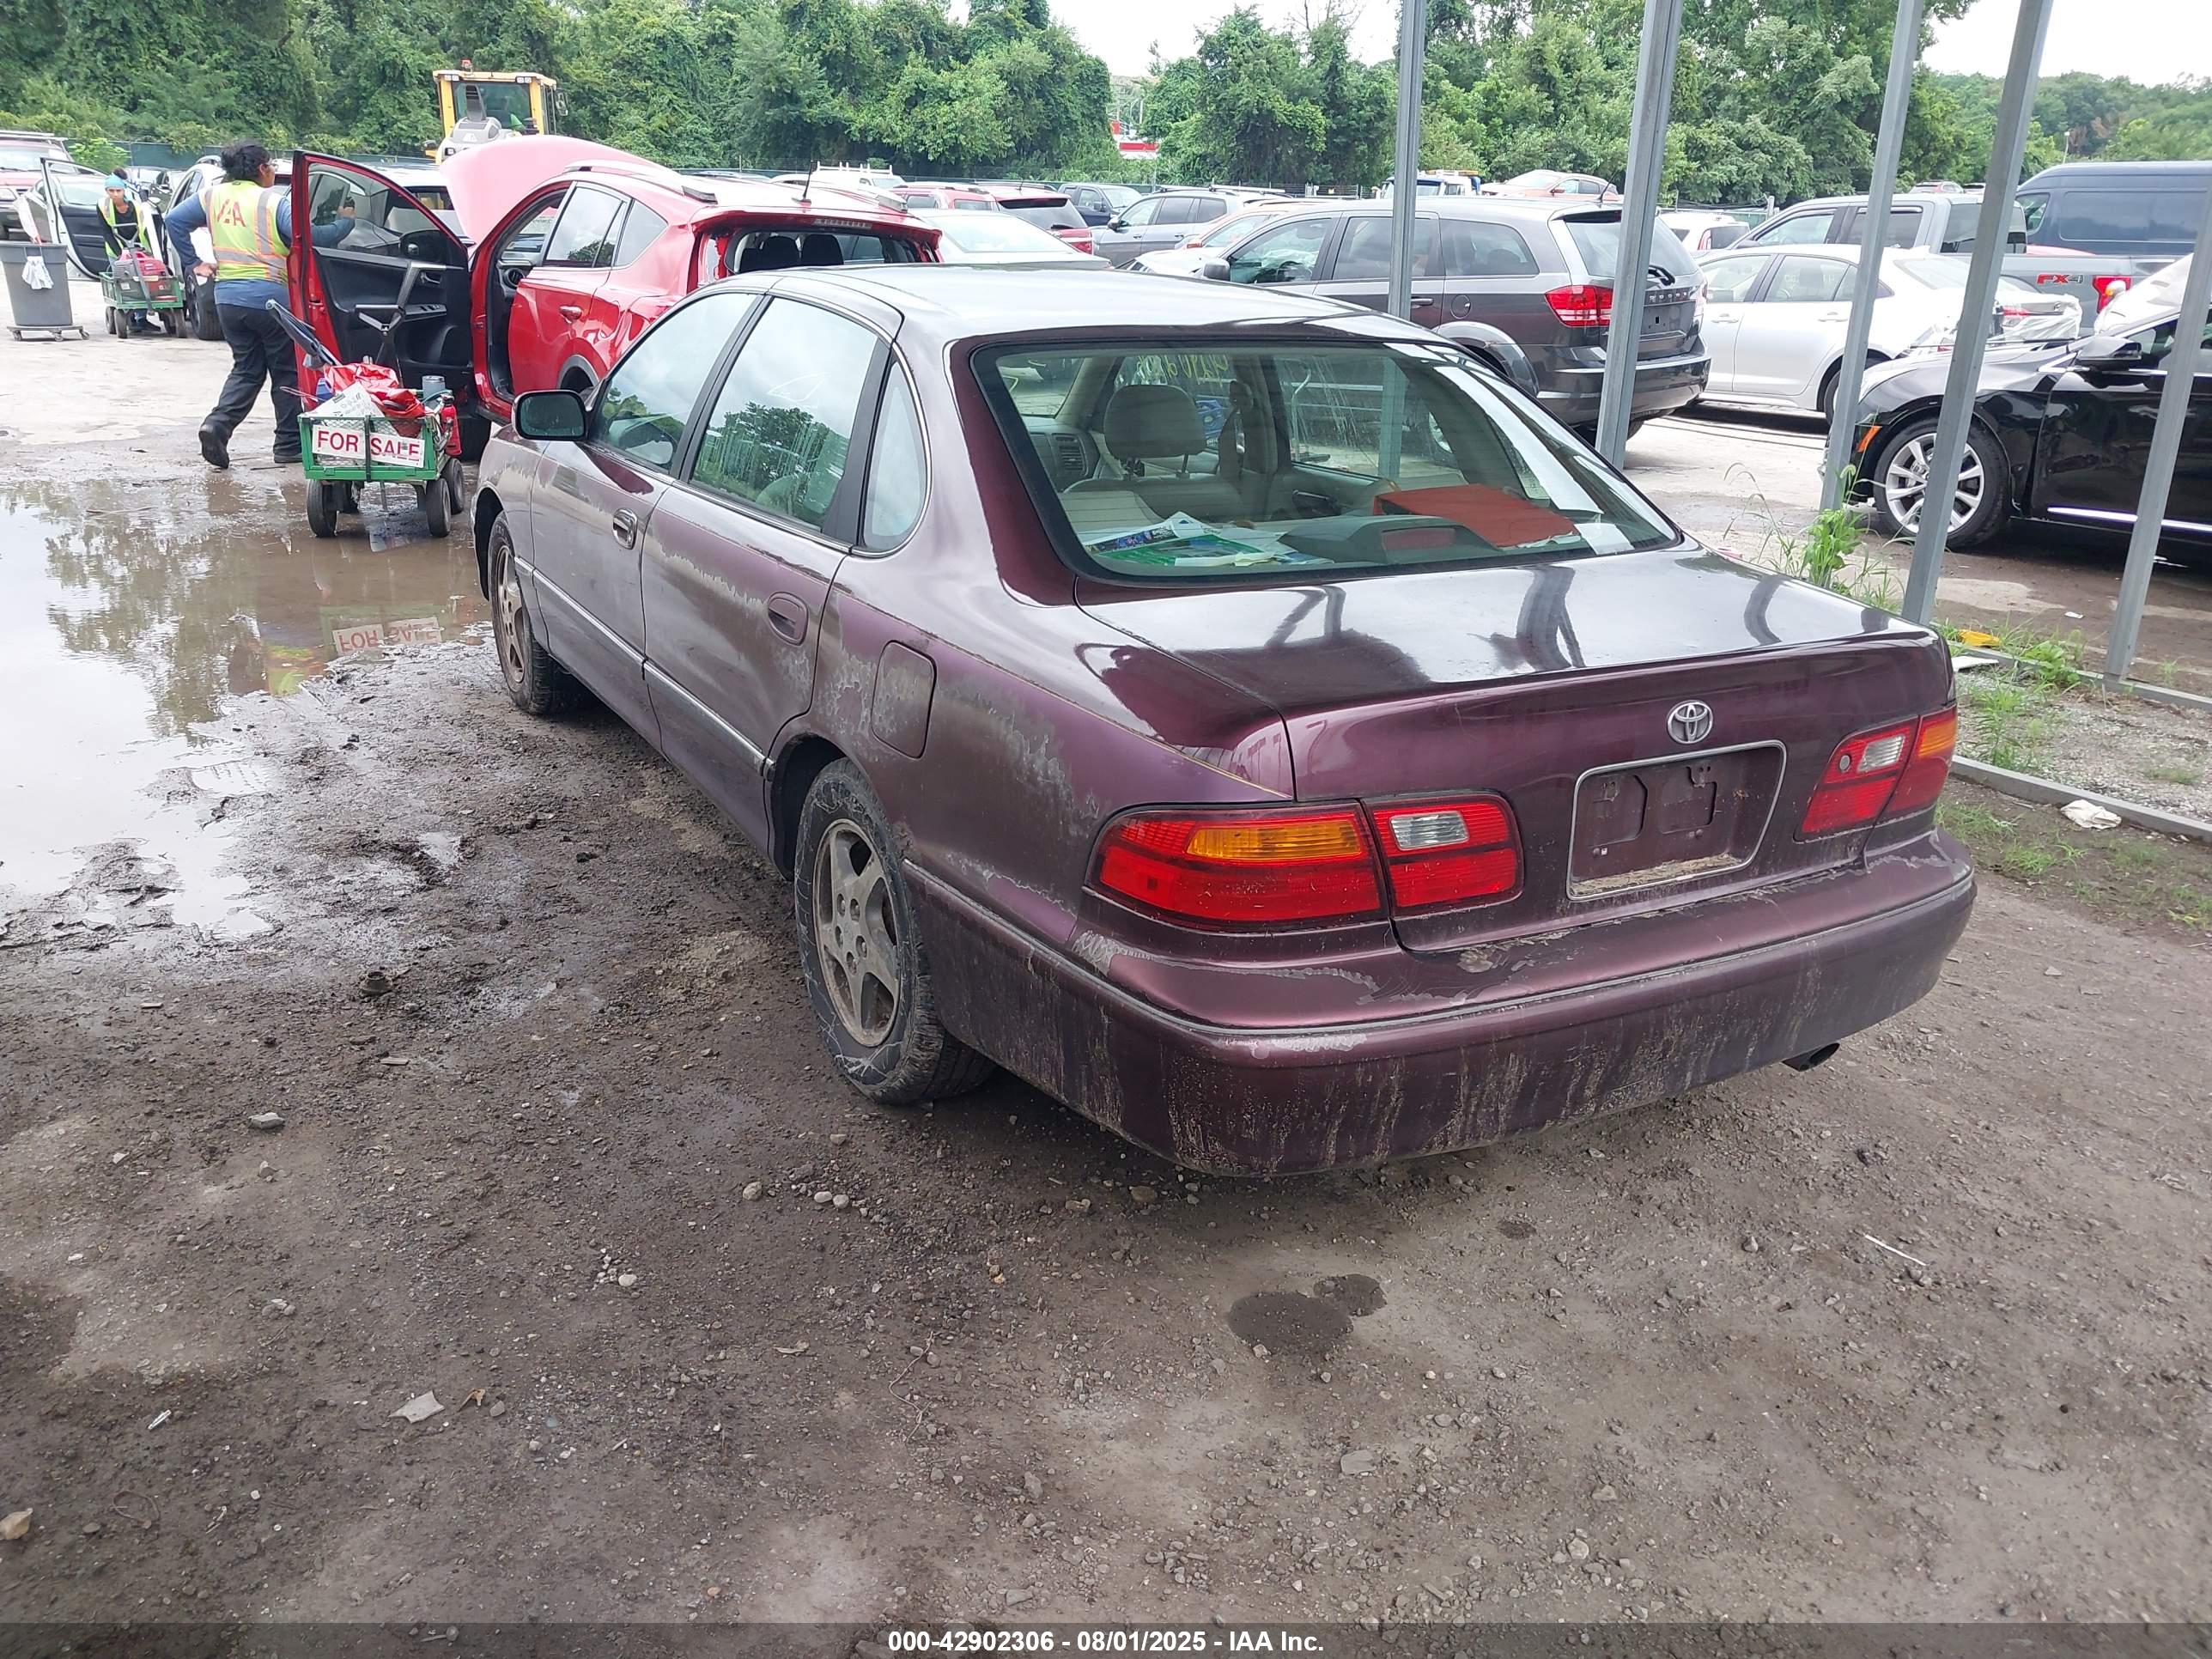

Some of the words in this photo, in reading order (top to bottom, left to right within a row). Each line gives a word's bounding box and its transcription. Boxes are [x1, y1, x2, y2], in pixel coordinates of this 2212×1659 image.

[2037, 273, 2084, 284] FX4
[318, 430, 358, 452] FOR
[371, 437, 420, 462] SALE
